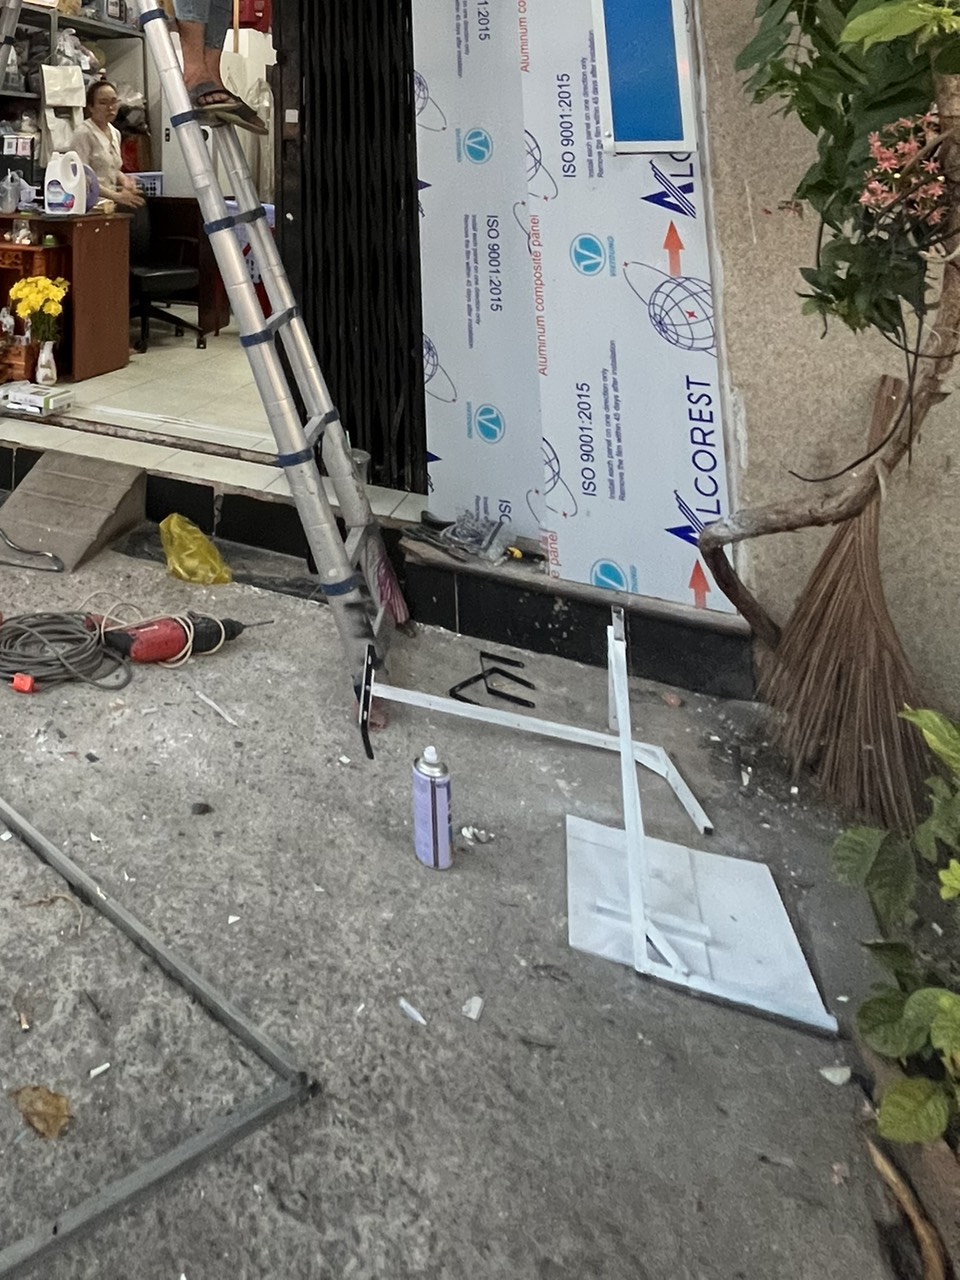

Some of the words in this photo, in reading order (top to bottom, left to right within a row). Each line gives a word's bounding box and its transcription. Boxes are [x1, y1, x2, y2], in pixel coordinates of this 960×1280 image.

[517, 16, 530, 73] Aluminum
[557, 73, 574, 146] 9001:2015
[561, 151, 576, 178] ISO
[487, 215, 499, 239] ISO
[529, 214, 542, 248] panel
[488, 243, 502, 311] 9001:2015
[530, 250, 546, 311] composite
[536, 316, 548, 376] Aluminum
[576, 383, 595, 463] 9001:2015
[581, 467, 597, 497] ISO
[546, 531, 562, 567] panel
